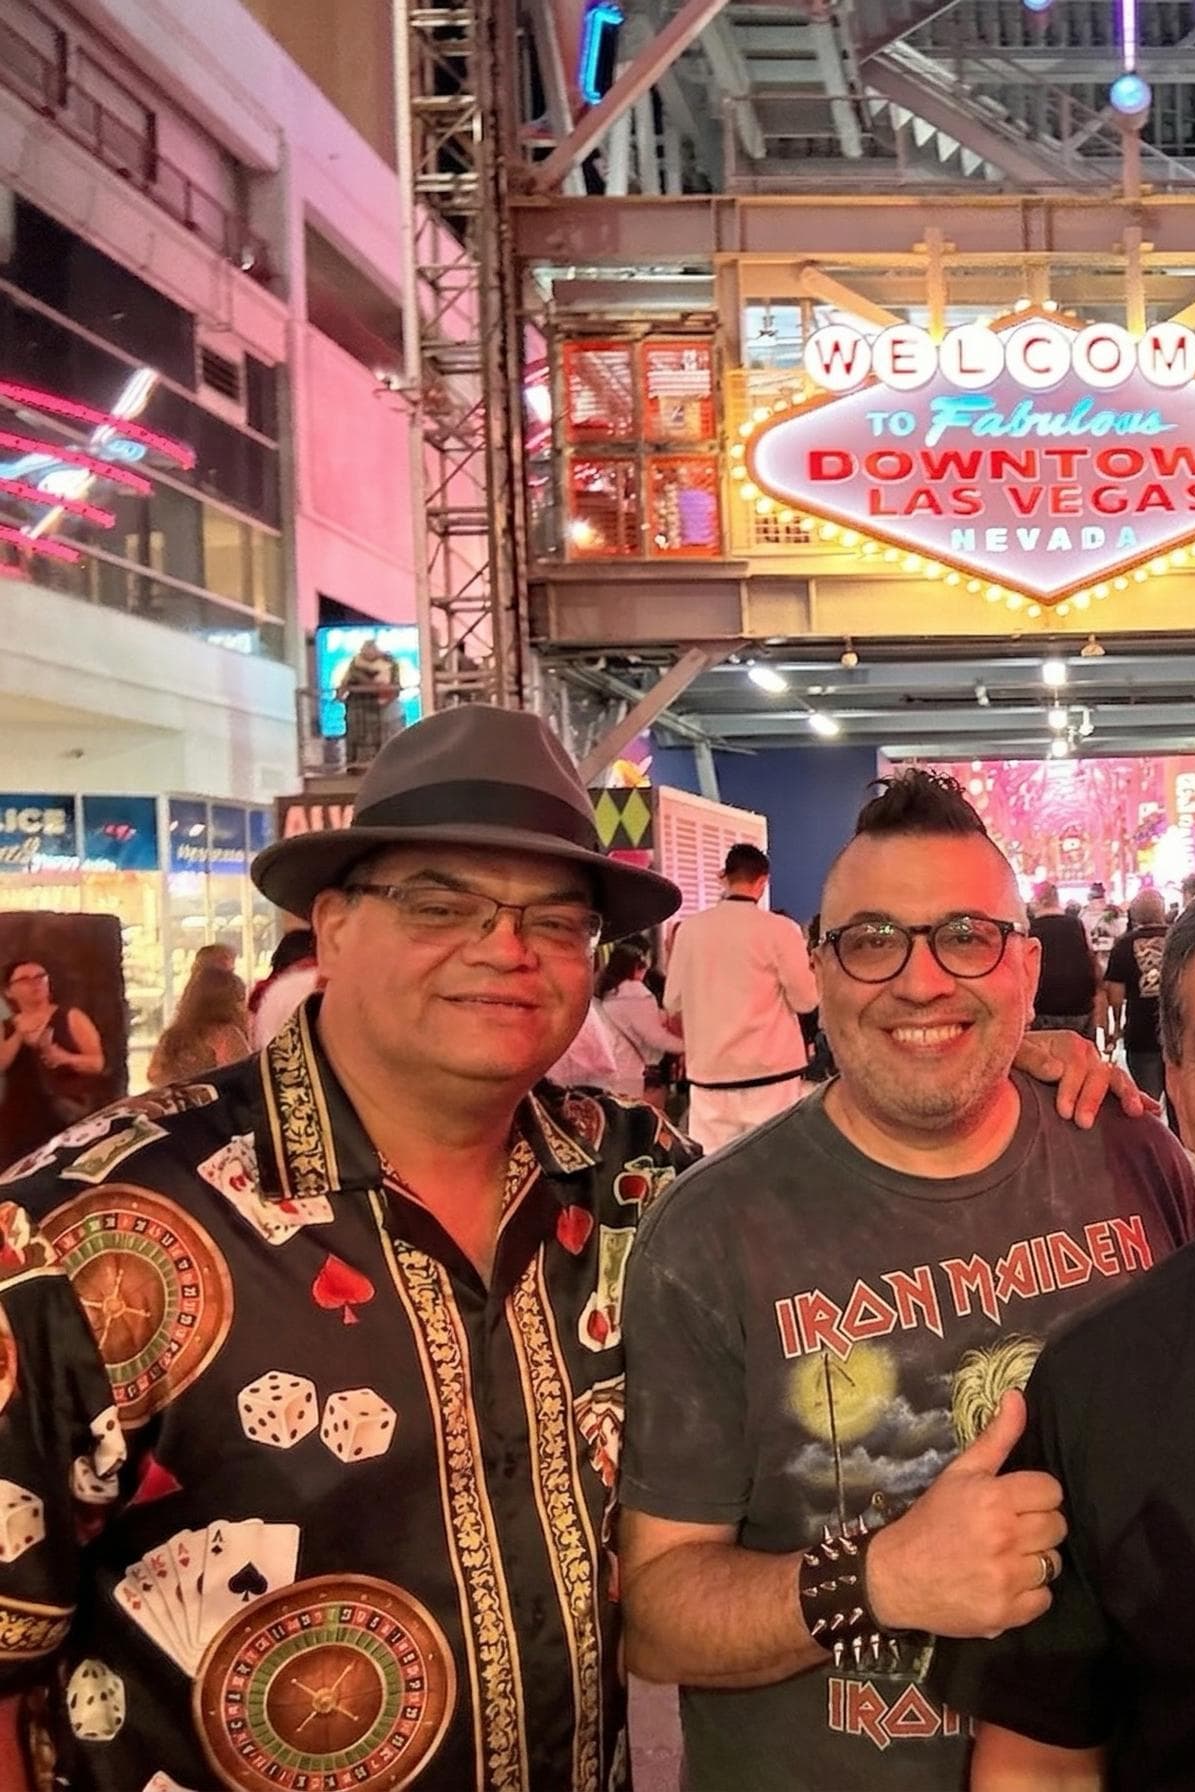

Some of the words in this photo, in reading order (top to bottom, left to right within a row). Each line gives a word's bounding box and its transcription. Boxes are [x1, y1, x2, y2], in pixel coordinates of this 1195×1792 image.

[865, 410, 917, 436] TO
[923, 393, 1179, 448] Fabulous
[866, 486, 987, 518] LAS
[949, 525, 1139, 553] NEVADA
[775, 1265, 944, 1362] IRON
[940, 1215, 1154, 1327] MAIDEN
